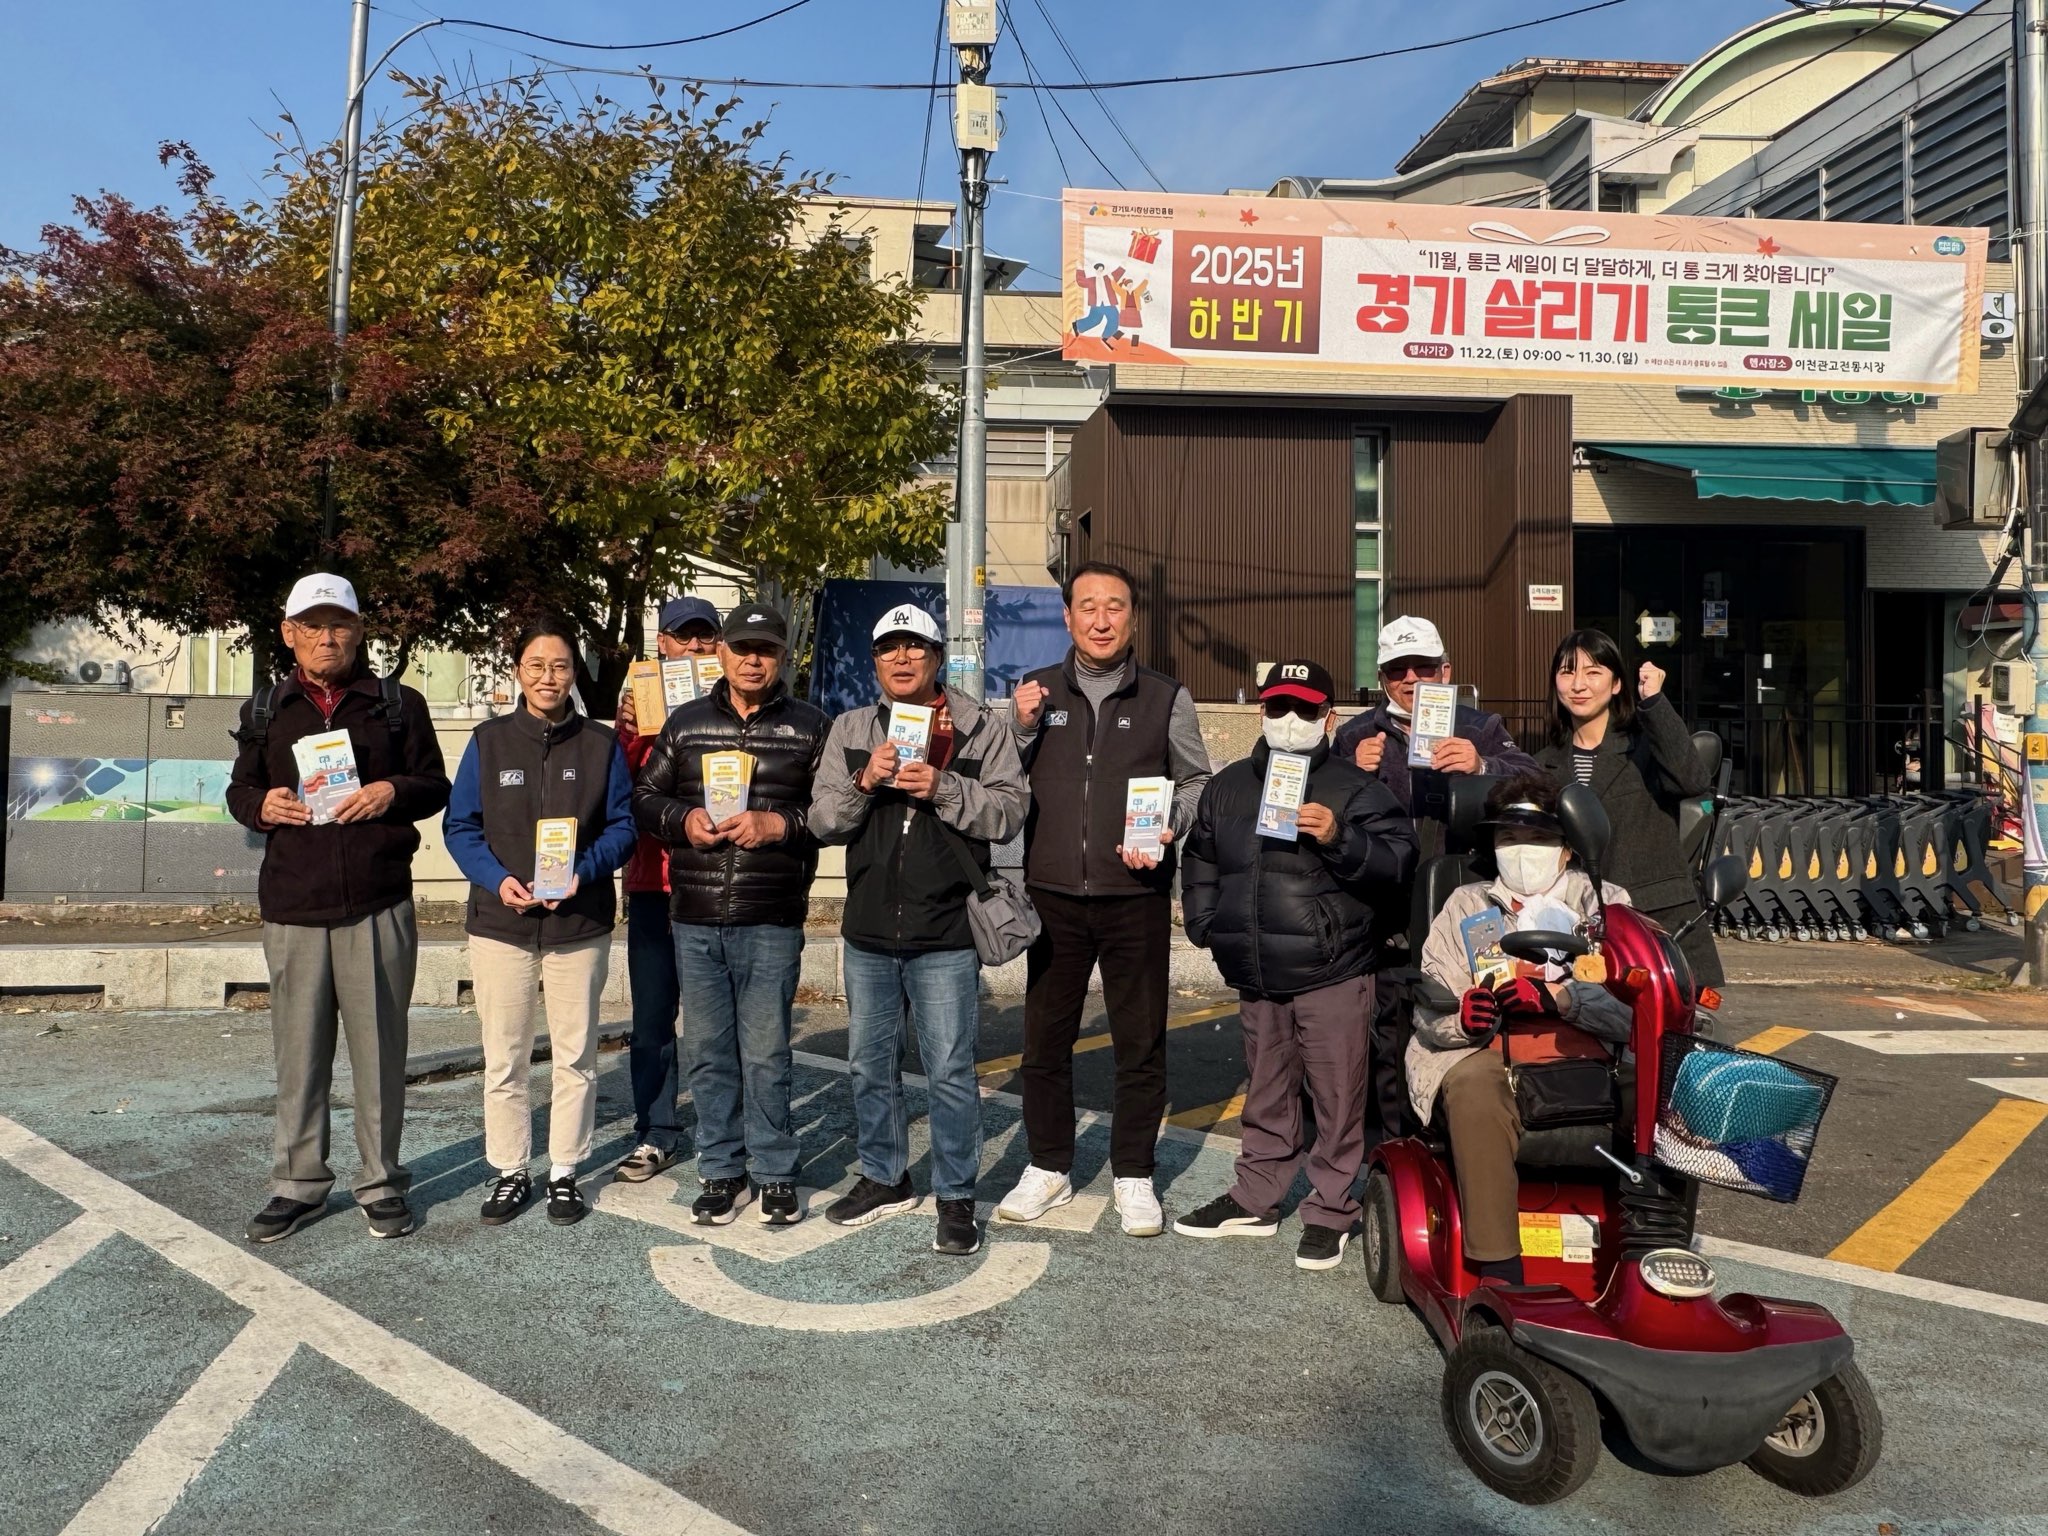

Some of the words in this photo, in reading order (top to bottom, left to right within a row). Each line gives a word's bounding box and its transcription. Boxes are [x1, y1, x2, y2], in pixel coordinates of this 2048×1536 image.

[1190, 243, 1305, 289] 2025년
[1467, 252, 1501, 272] 통큰
[1506, 254, 1556, 274] 세일이
[1563, 256, 1579, 275] 더
[1585, 257, 1656, 280] 달달하게,
[1662, 260, 1678, 279] 더
[1683, 261, 1700, 280] 통
[1704, 262, 1738, 282] 크게
[1356, 273, 1466, 336] 경기
[1484, 278, 1650, 343] 살리기
[1666, 285, 1771, 348] 통큰
[1788, 290, 1893, 352] 세일
[1409, 345, 1449, 357] 행사기간
[1460, 346, 1519, 361] 11.22.(토)
[1523, 349, 1563, 361] 09:00
[1579, 351, 1639, 365] 11.30.(일)
[1749, 357, 1787, 369] 행사장소
[1795, 358, 1886, 374] 이천관고전통시장
[1281, 664, 1309, 678] ITG
